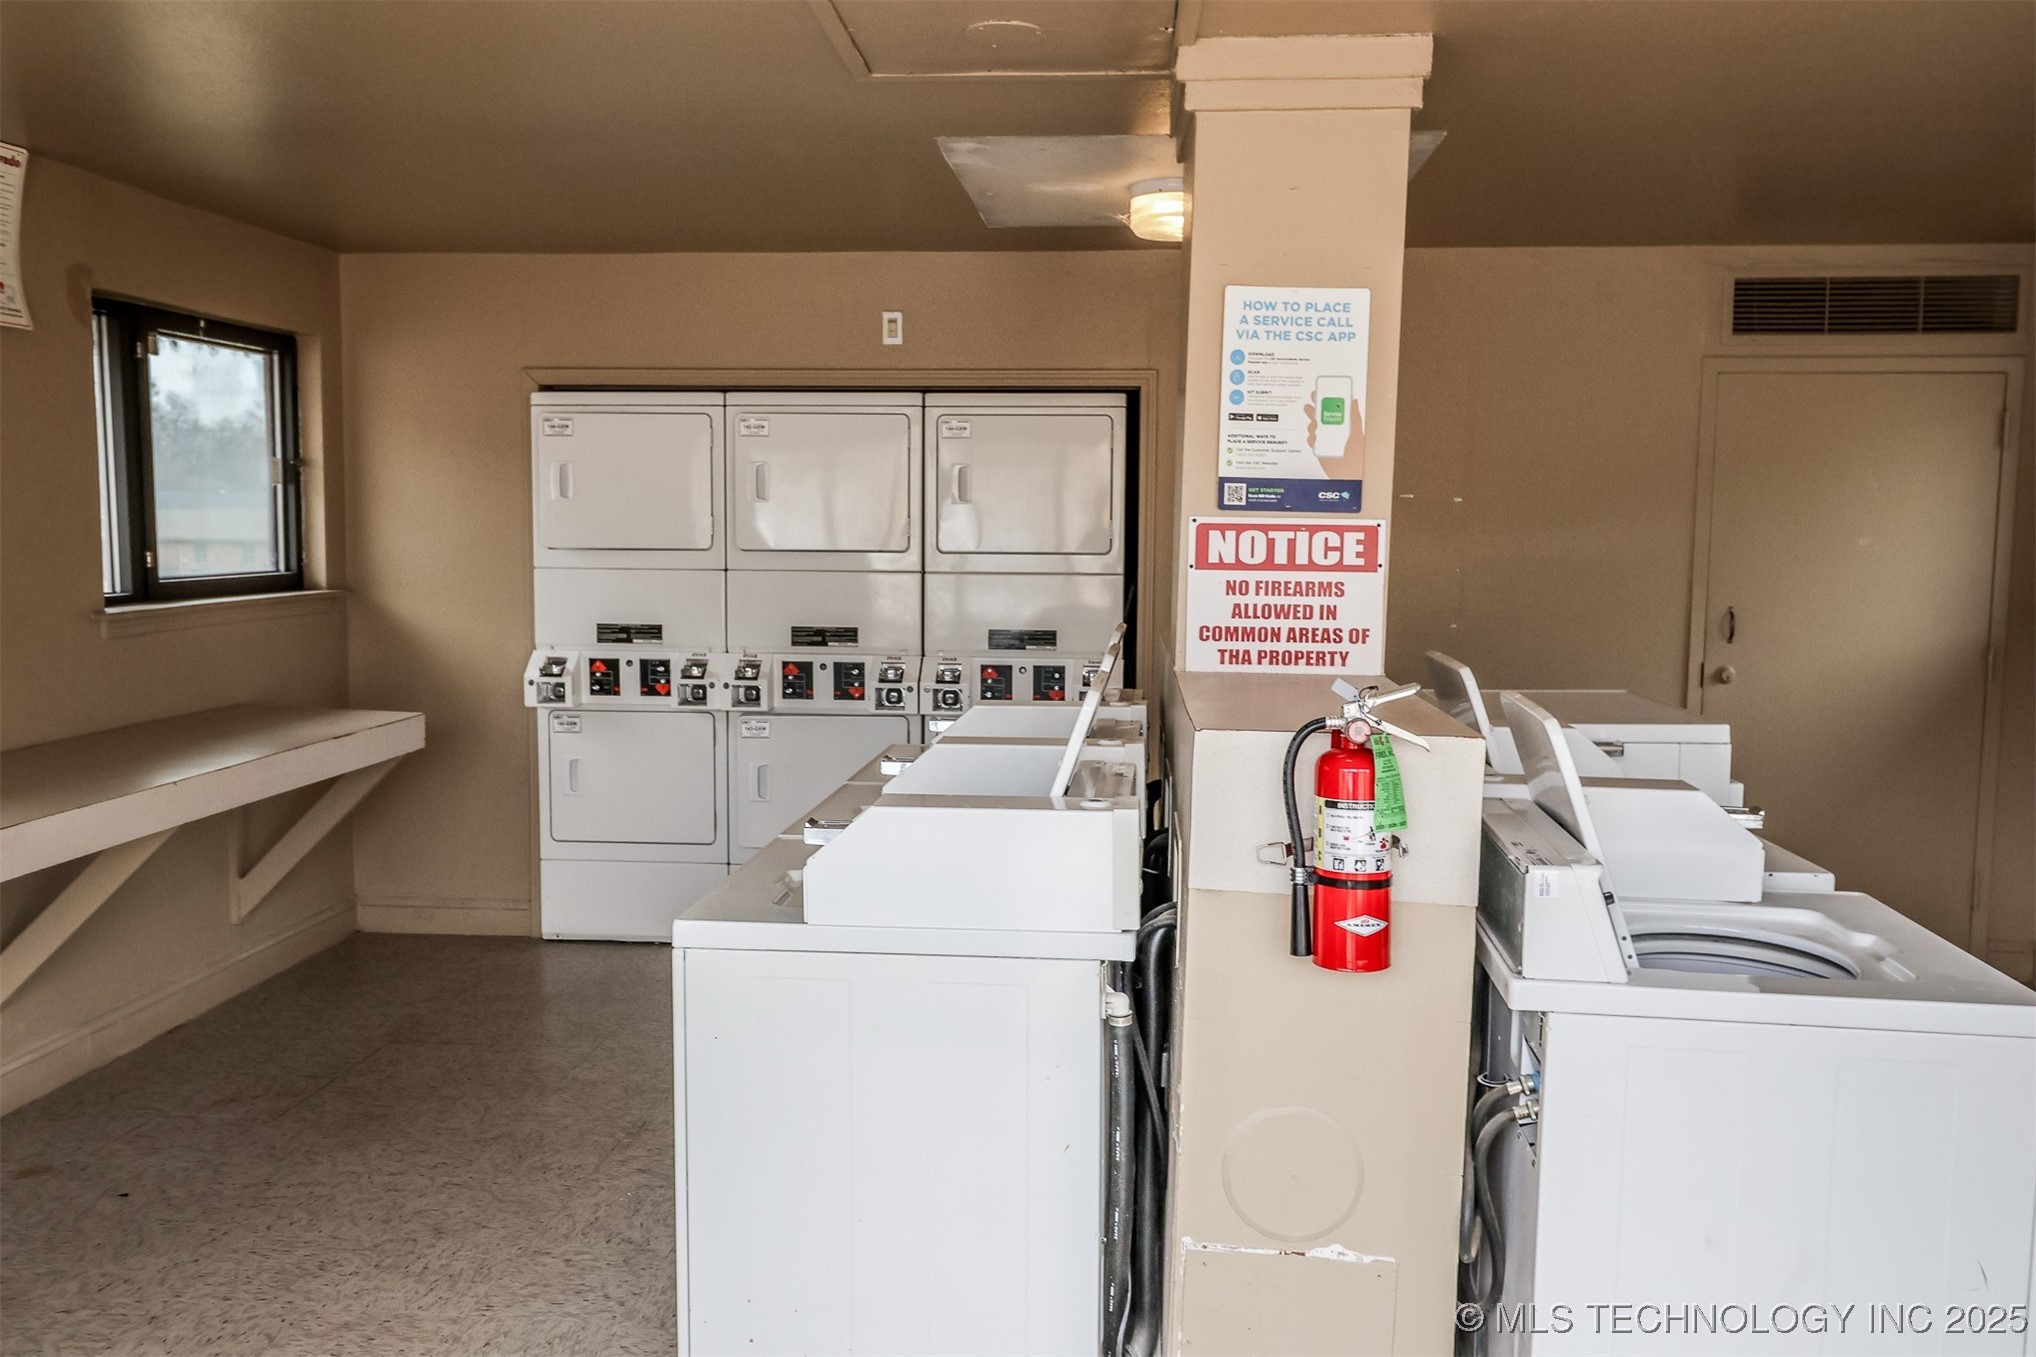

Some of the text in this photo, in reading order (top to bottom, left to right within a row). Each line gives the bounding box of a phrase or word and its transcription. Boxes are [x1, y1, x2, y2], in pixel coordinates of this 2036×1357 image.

[1243, 301, 1351, 313] HOW TO PLACE
[1239, 315, 1353, 327] A SERVICE CALL
[1236, 329, 1356, 342] VIA THE CSC APP
[1318, 491, 1340, 499] CSC
[1208, 530, 1365, 566] NOTICE
[1225, 580, 1345, 597] NO FIREARMS
[1231, 603, 1337, 620] ALLOWED IN
[1198, 625, 1370, 644] COMMON AREAS OF
[1217, 649, 1349, 667] THA PROPERTY
